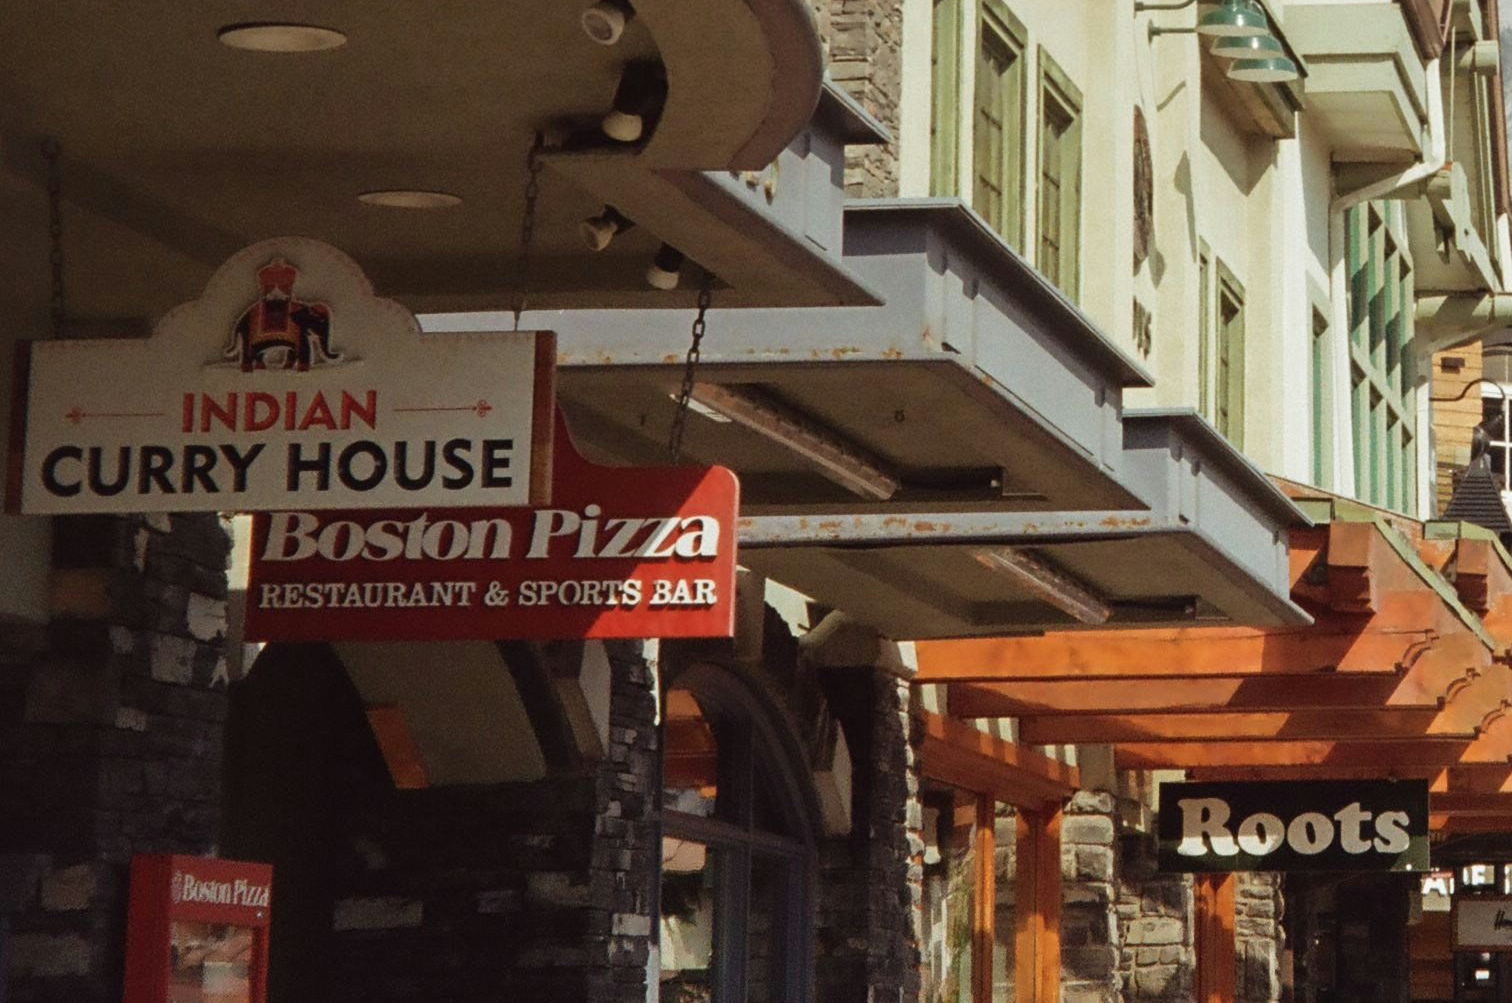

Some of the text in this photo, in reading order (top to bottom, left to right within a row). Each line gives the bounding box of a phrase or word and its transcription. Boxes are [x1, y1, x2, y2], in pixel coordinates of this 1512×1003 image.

[182, 389, 378, 433] INDIAN
[41, 438, 514, 497] CURRY HOUSE
[259, 503, 721, 561] Boston Pizza
[258, 577, 719, 609] RESTAURANT & SPORTS BAR
[1176, 797, 1411, 857] Roots
[182, 873, 270, 907] Boston Pizza
